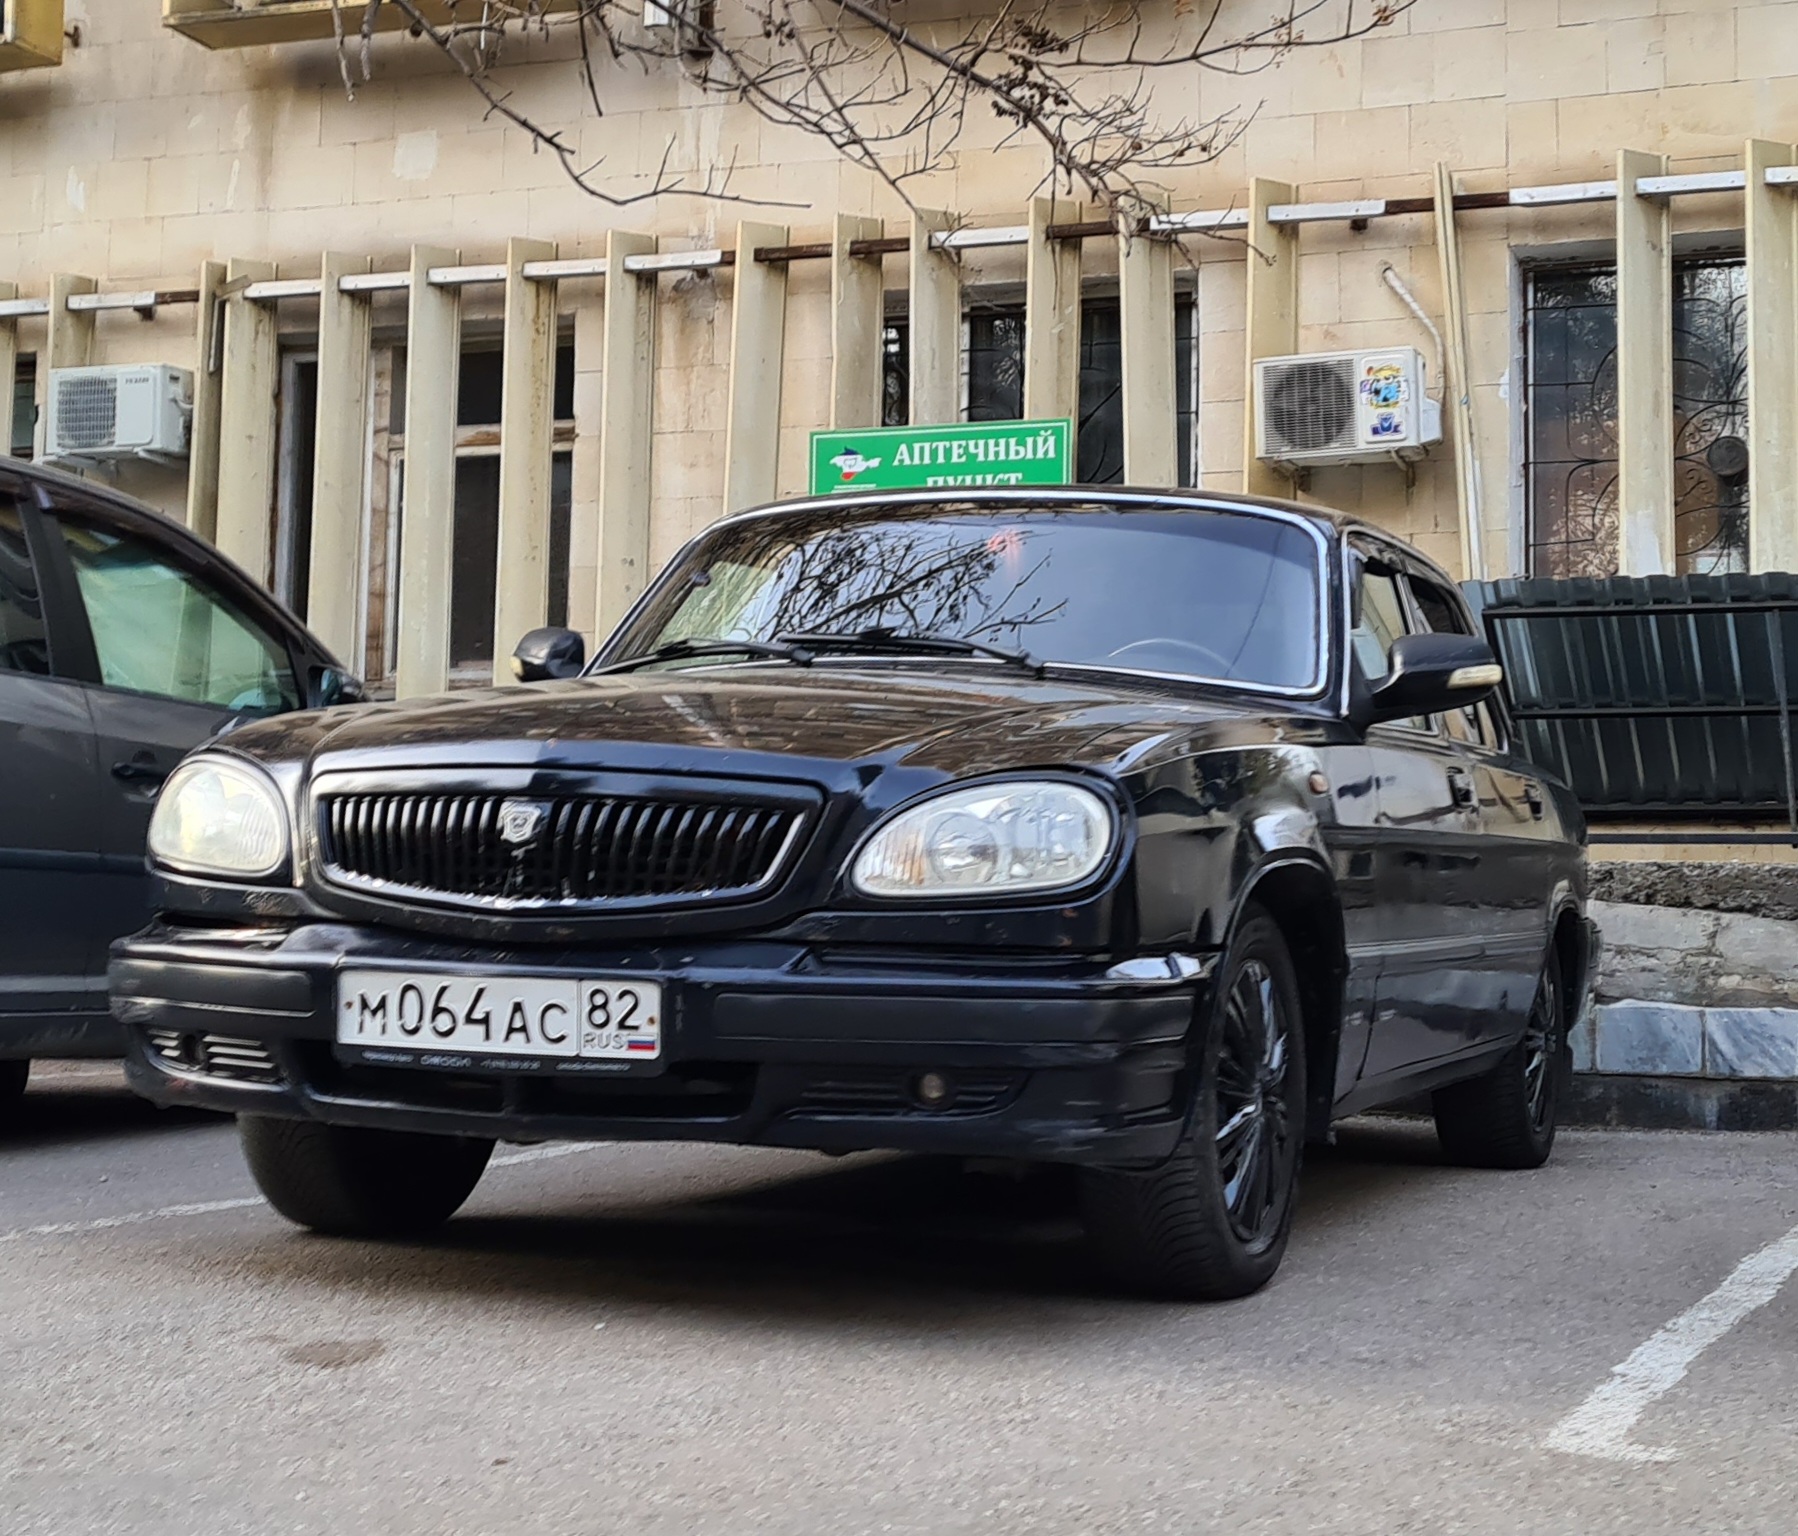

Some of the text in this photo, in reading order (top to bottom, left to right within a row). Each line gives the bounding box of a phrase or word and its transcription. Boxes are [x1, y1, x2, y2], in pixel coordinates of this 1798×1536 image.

[892, 430, 1056, 466] АПТЕЧНЫЙ
[358, 981, 641, 1044] М064АС 82
[583, 1033, 625, 1050] RUS
